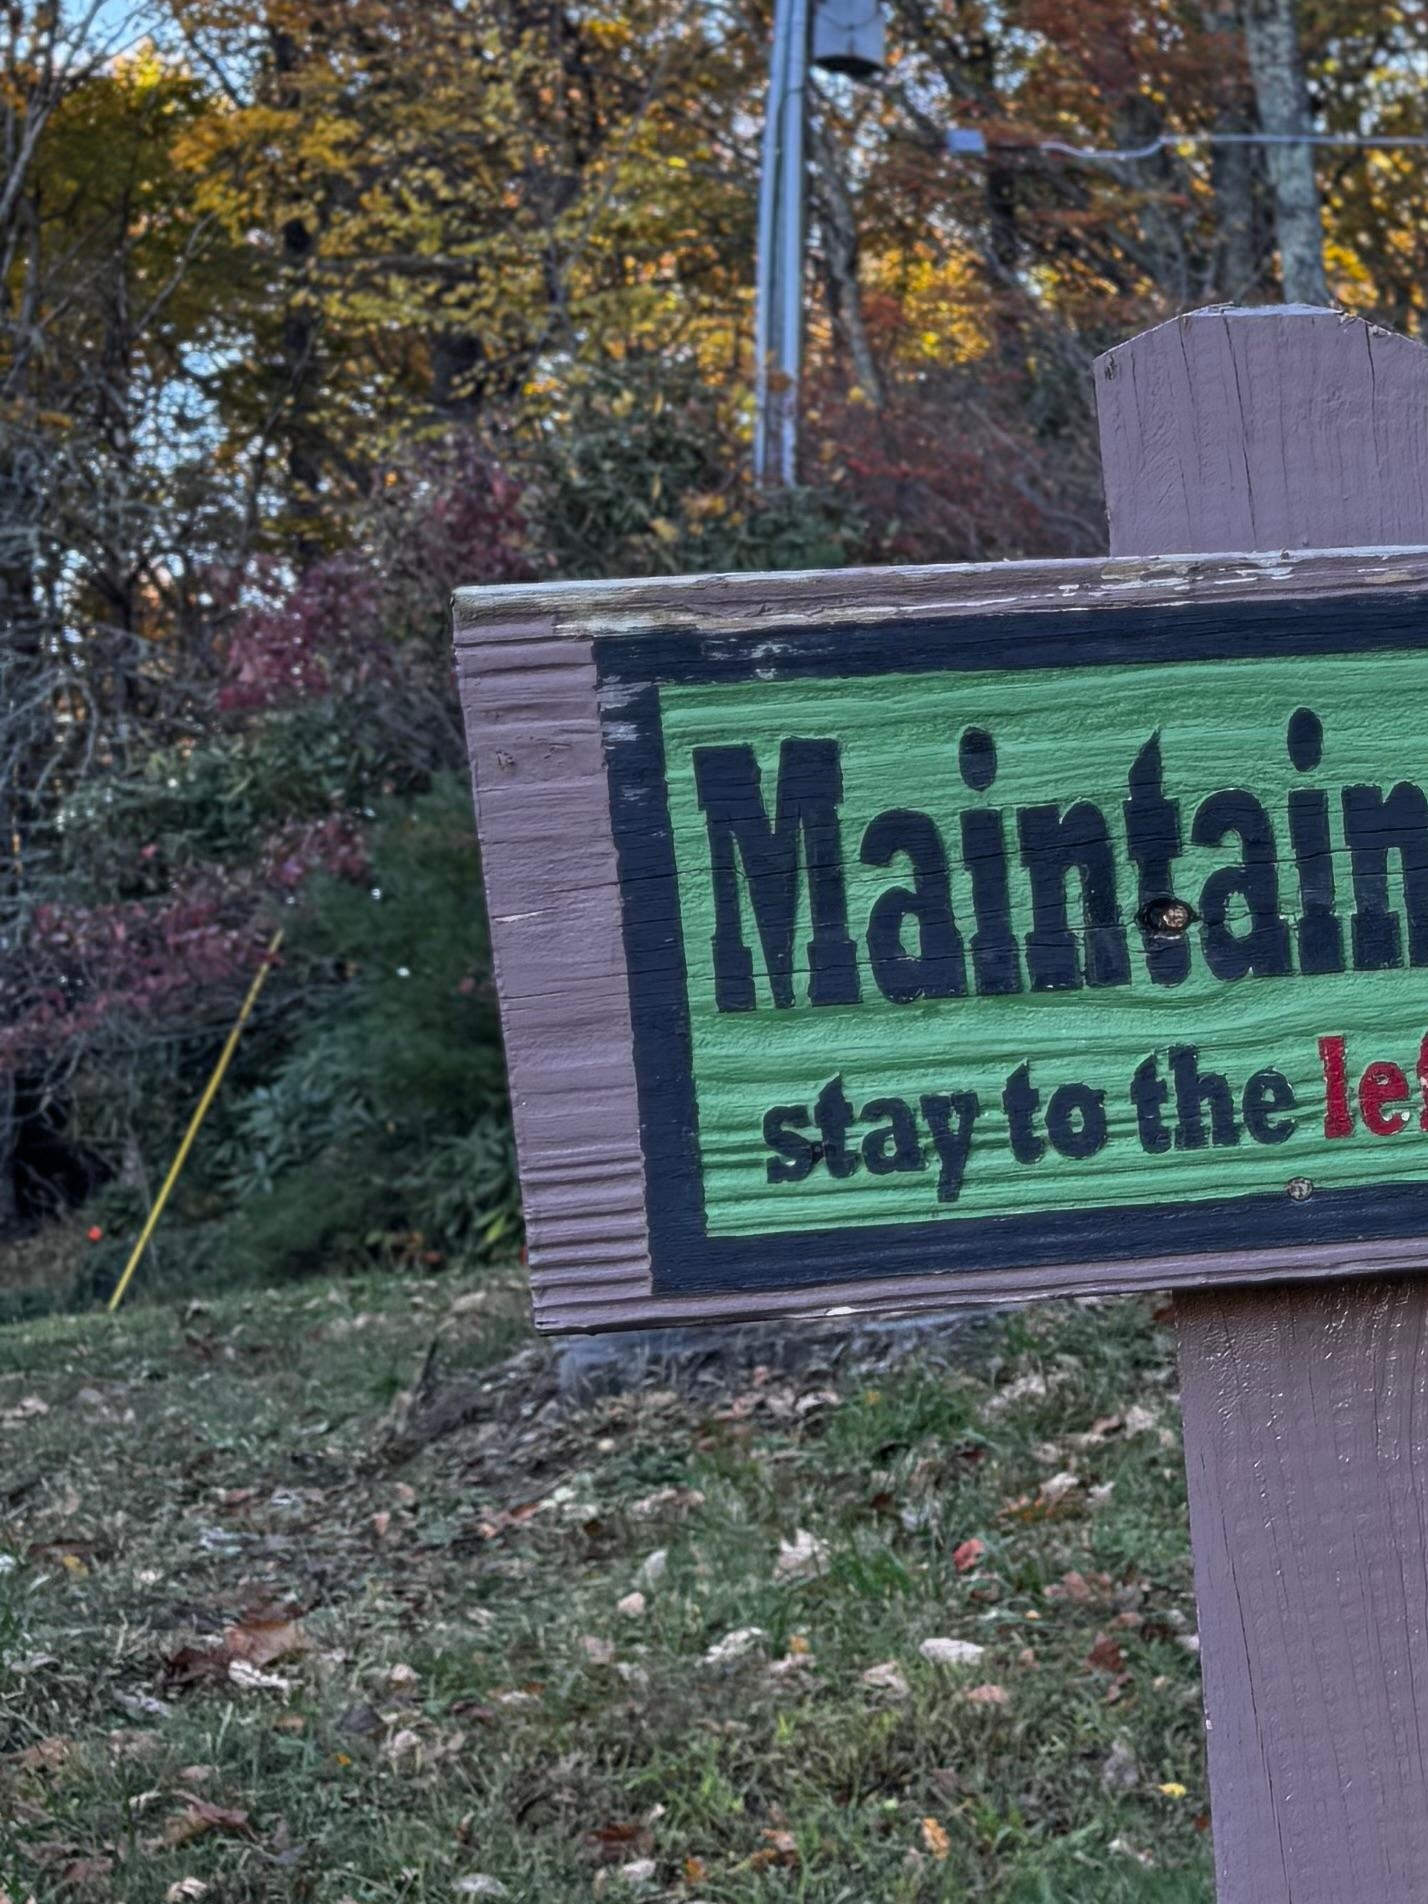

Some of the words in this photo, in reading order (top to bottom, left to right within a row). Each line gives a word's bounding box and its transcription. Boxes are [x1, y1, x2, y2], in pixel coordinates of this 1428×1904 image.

[765, 1075, 978, 1201] stay
[1005, 1062, 1106, 1163] to
[1132, 1047, 1296, 1153] the
